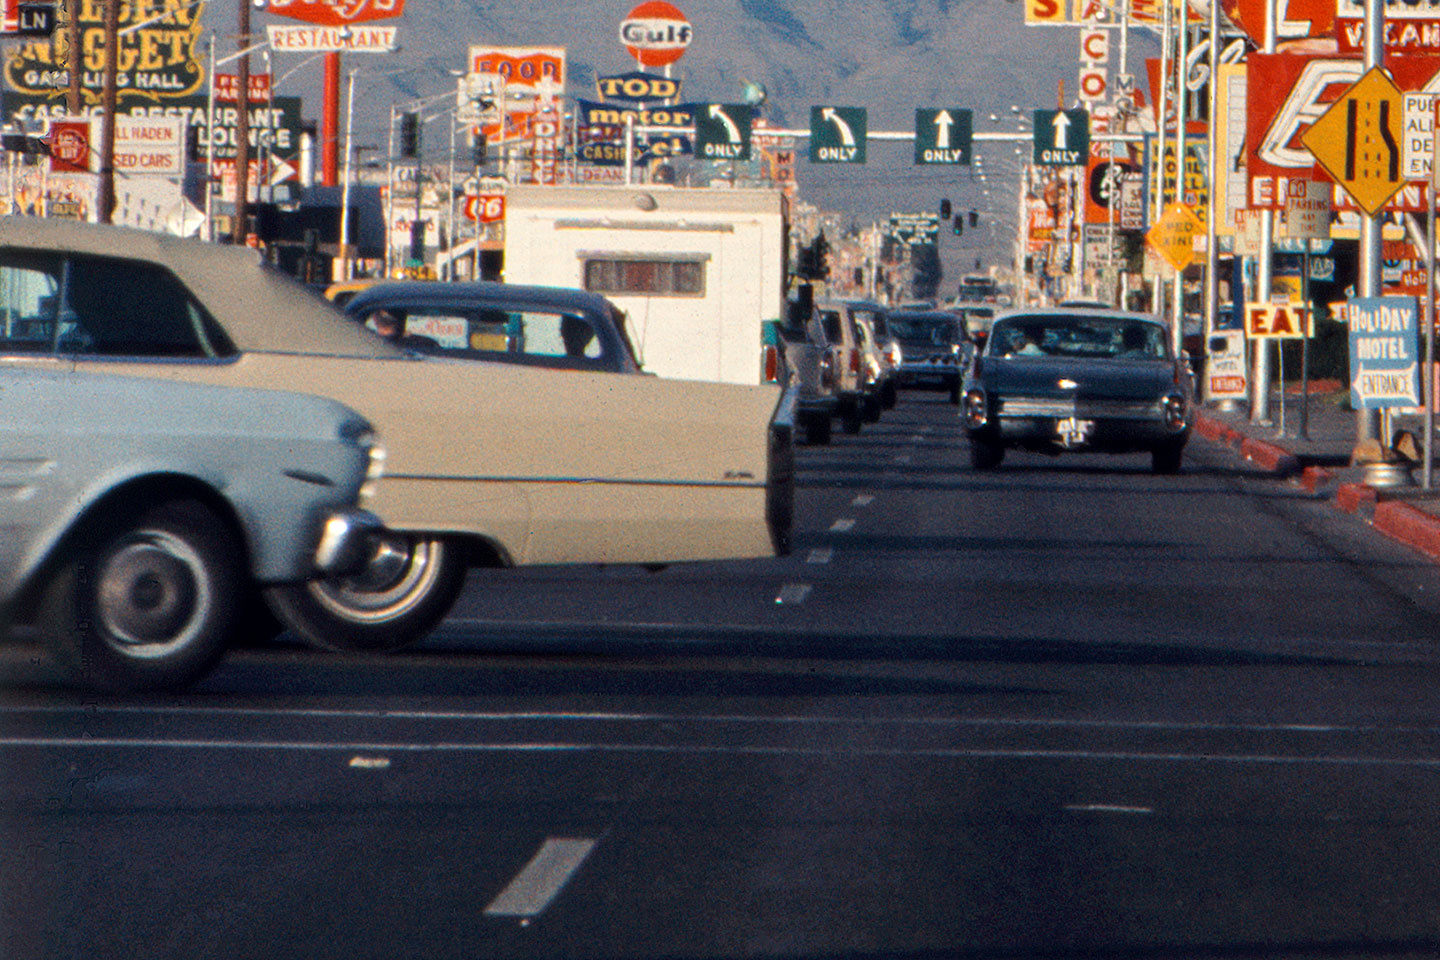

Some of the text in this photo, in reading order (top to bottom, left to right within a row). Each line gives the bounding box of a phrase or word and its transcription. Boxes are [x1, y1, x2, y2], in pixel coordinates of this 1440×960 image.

[622, 22, 692, 44] Gulf
[136, 74, 185, 88] HALL
[600, 78, 677, 98] TOD
[589, 109, 691, 125] motor
[704, 142, 743, 157] ONLY
[818, 146, 857, 161] ONLY
[923, 149, 962, 163] ONLY
[1042, 150, 1080, 163] ONLY
[139, 154, 173, 168] CARS
[1356, 337, 1408, 360] MOTEL
[1362, 374, 1412, 395] ENTRANCE
